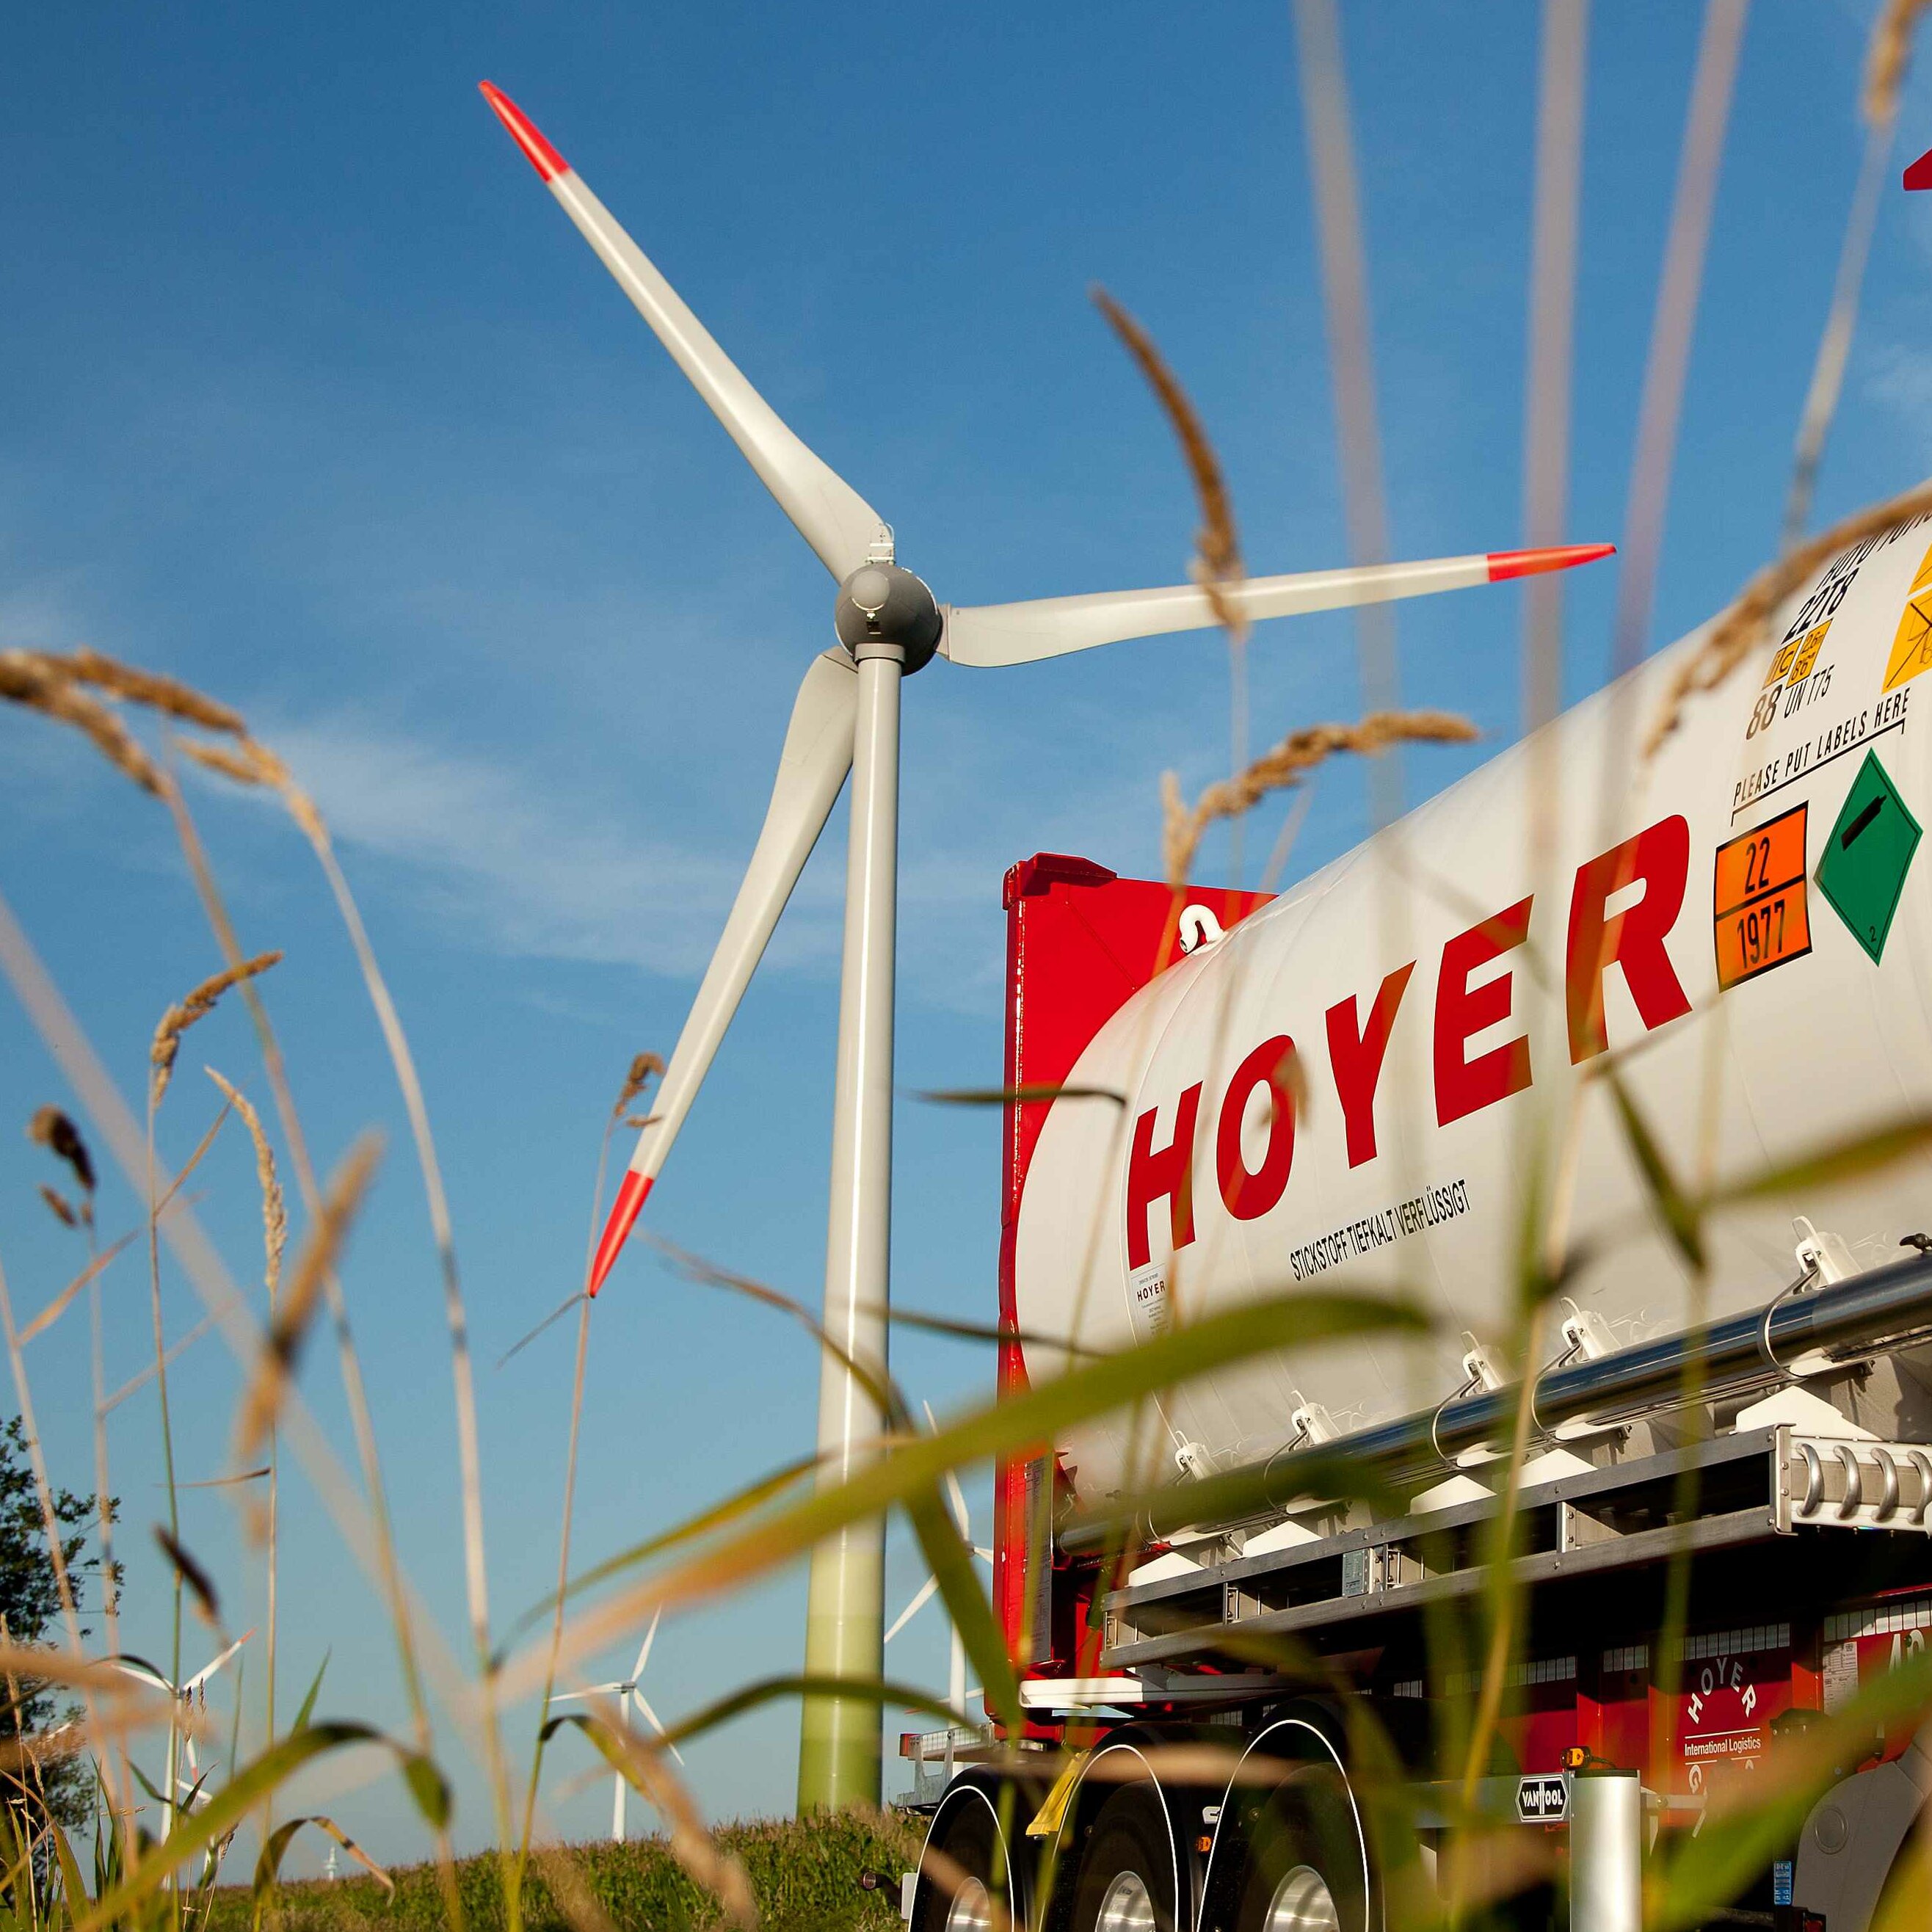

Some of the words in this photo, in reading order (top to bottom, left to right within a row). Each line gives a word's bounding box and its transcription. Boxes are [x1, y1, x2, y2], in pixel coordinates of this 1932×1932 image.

[1781, 567, 1859, 644] 22T8
[1746, 684, 1783, 740] 88
[1784, 679, 1808, 719] UN
[1806, 664, 1834, 705] T75
[1733, 759, 1780, 806] PLEASE
[1785, 742, 1811, 777] PUT
[1817, 711, 1867, 760] LABELS
[1874, 687, 1910, 728] HERE
[1744, 837, 1771, 895] 22
[1737, 898, 1786, 970] 1977
[1869, 926, 1877, 943] 2
[1127, 814, 1693, 1271] HOYER
[1290, 1230, 1348, 1282] STICKSTOFF
[1346, 1209, 1398, 1255] TIEFKALT
[1394, 1179, 1470, 1236] VERFLÜSSIGT
[1136, 1280, 1166, 1301] HOYER
[1688, 1657, 1757, 1724] HOYER
[1685, 1738, 1728, 1757] International
[1729, 1736, 1762, 1754] Logistics
[1522, 1782, 1563, 1815] VANTOOL
